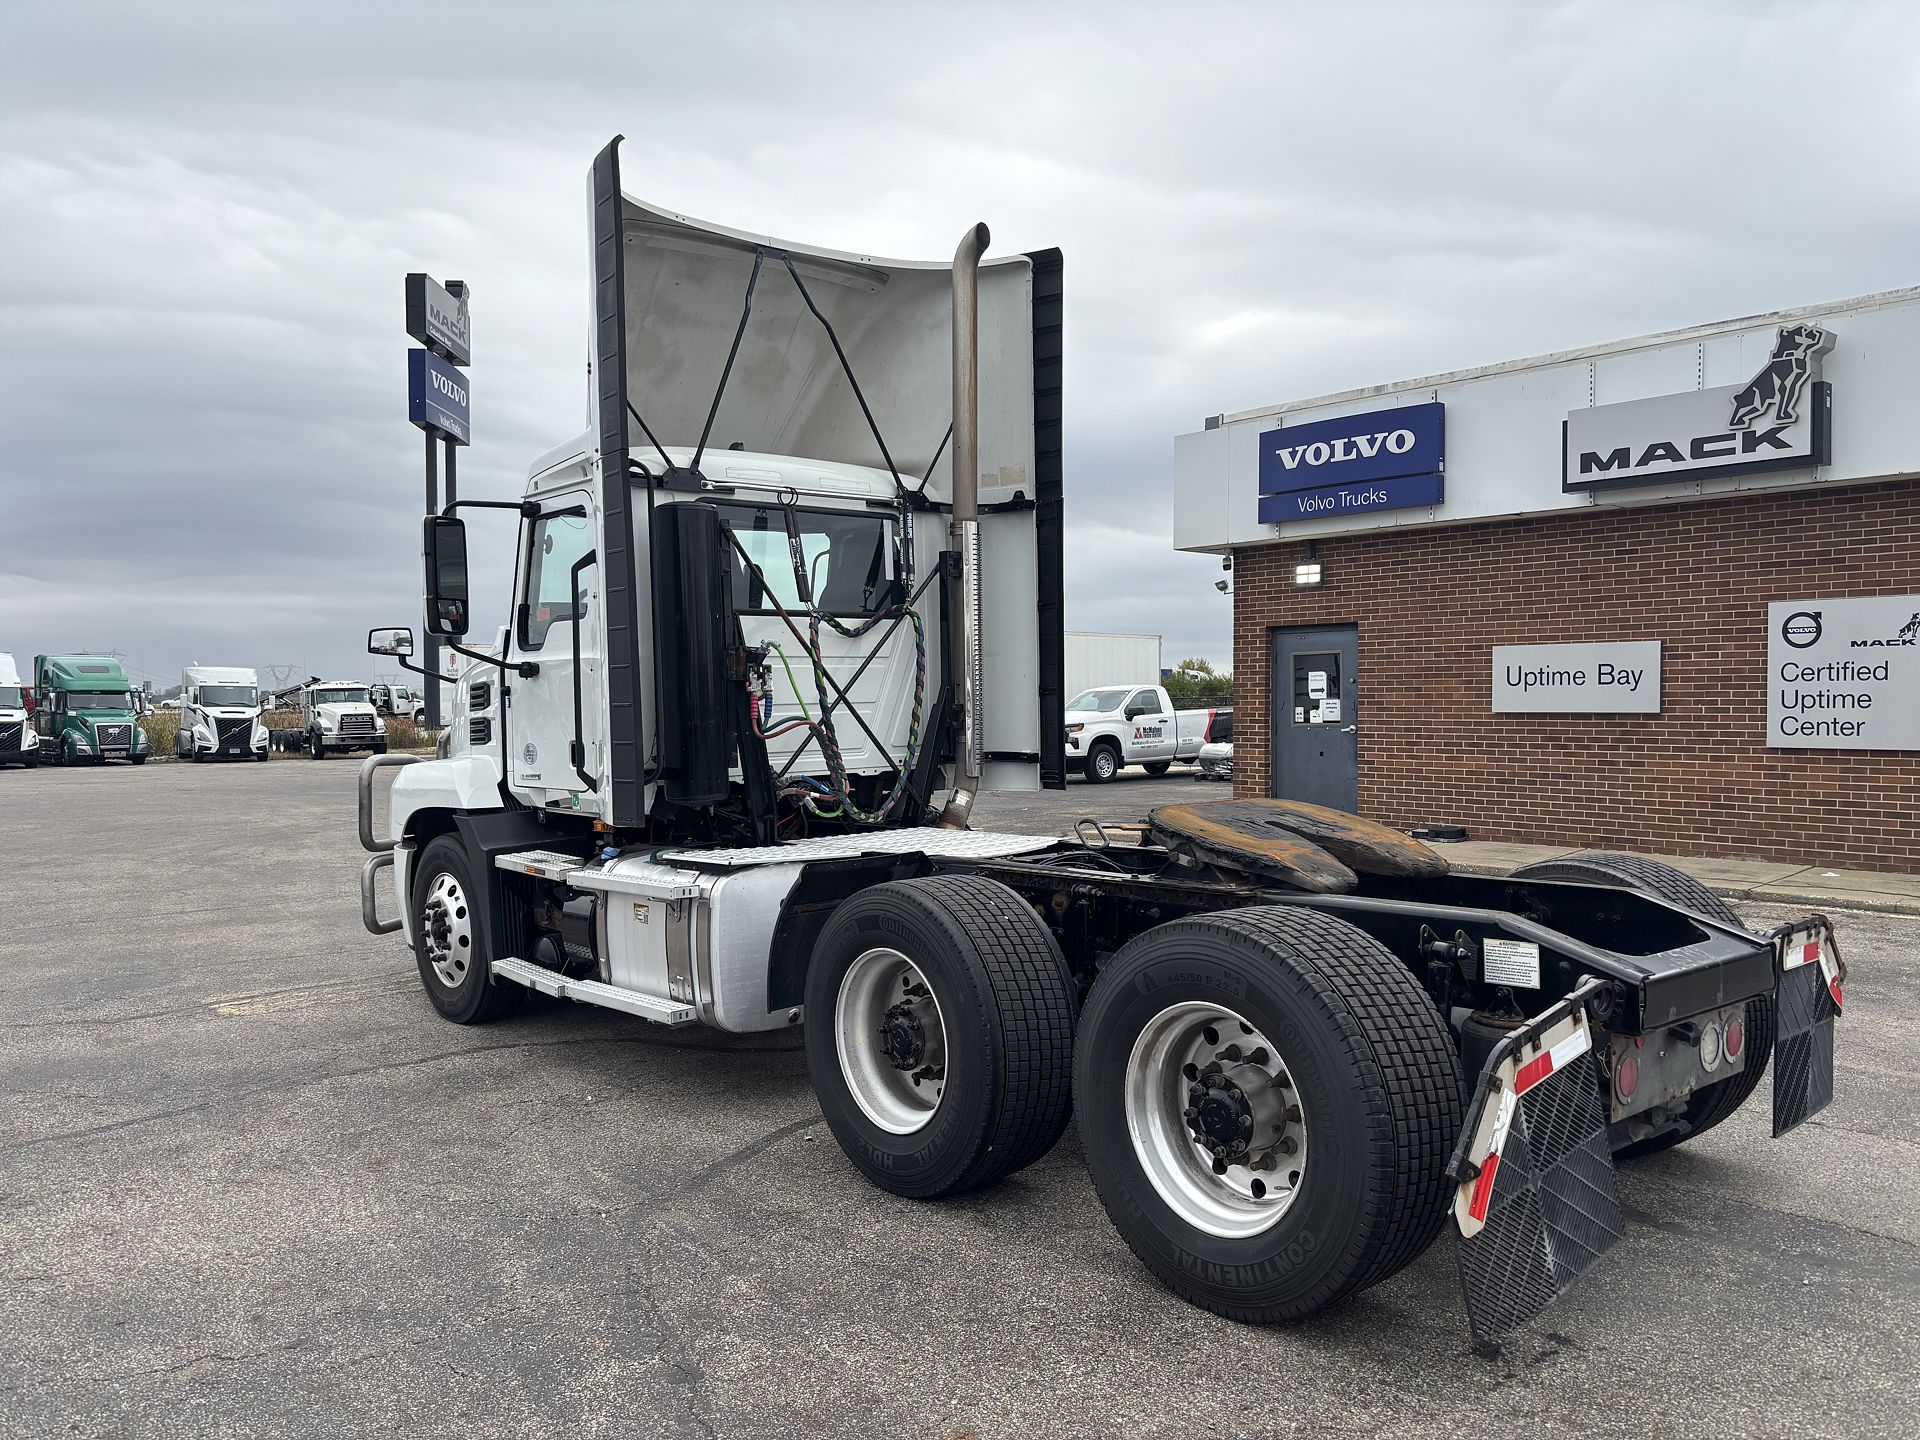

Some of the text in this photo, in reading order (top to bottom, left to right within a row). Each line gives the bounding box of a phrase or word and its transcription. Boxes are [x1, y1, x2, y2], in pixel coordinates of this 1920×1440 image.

[430, 304, 467, 344] MACK
[431, 369, 467, 407] VOLVO
[438, 412, 451, 429] Volvo
[1275, 429, 1416, 470] VOLVO
[1579, 425, 1793, 474] MACK
[1297, 487, 1387, 513] Volvo Trucks
[1787, 626, 1817, 634] VOLVO
[1850, 638, 1917, 648] MACK
[1506, 663, 1644, 693] Uptime Bay
[1780, 660, 1889, 683] Certified
[1780, 689, 1873, 714] Uptime
[1779, 715, 1866, 737] Center
[1170, 1229, 1318, 1287] CONTINENTAL
